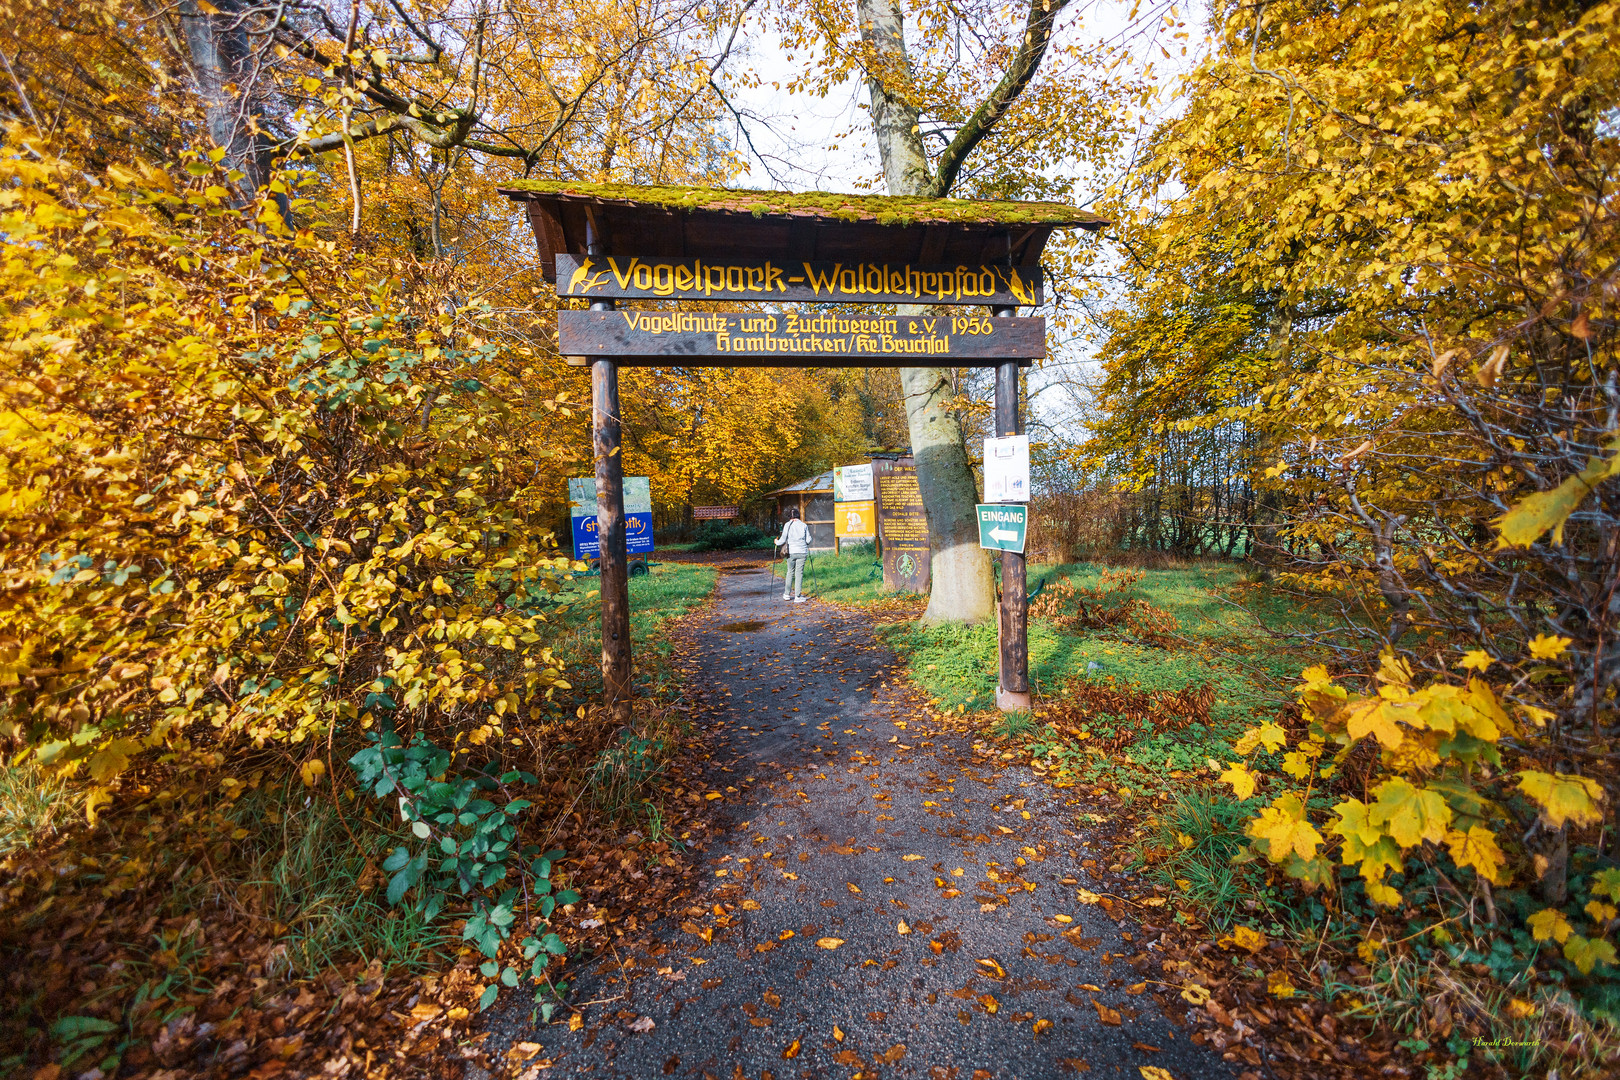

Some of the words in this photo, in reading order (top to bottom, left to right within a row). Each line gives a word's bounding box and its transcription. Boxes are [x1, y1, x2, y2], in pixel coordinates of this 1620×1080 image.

[740, 314, 777, 333] und
[785, 314, 898, 334] Zuchtverein
[909, 318, 937, 334] e.V.
[951, 317, 993, 335] 1956
[981, 511, 1023, 523] EINGANG
